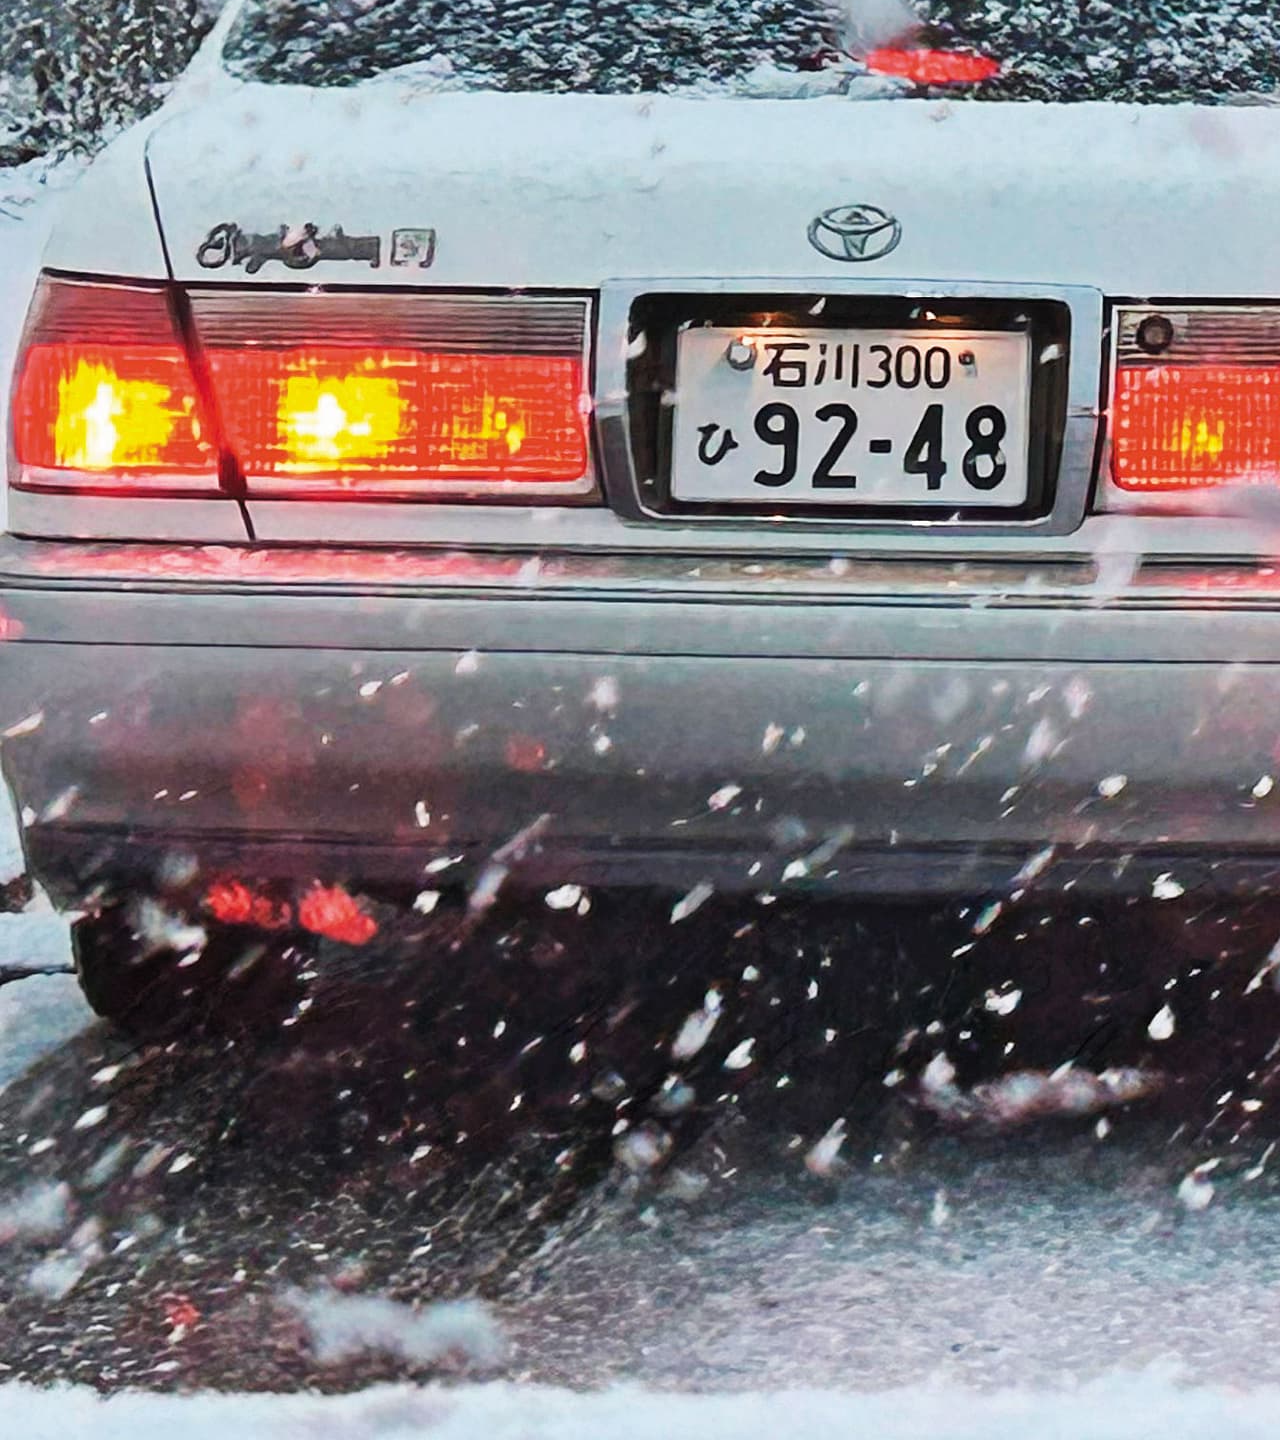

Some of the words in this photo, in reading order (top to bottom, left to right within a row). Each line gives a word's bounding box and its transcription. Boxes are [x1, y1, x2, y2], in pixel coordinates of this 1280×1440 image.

[762, 343, 951, 389] 石川300
[697, 422, 738, 465] ひ
[753, 402, 1007, 491] 92-48
